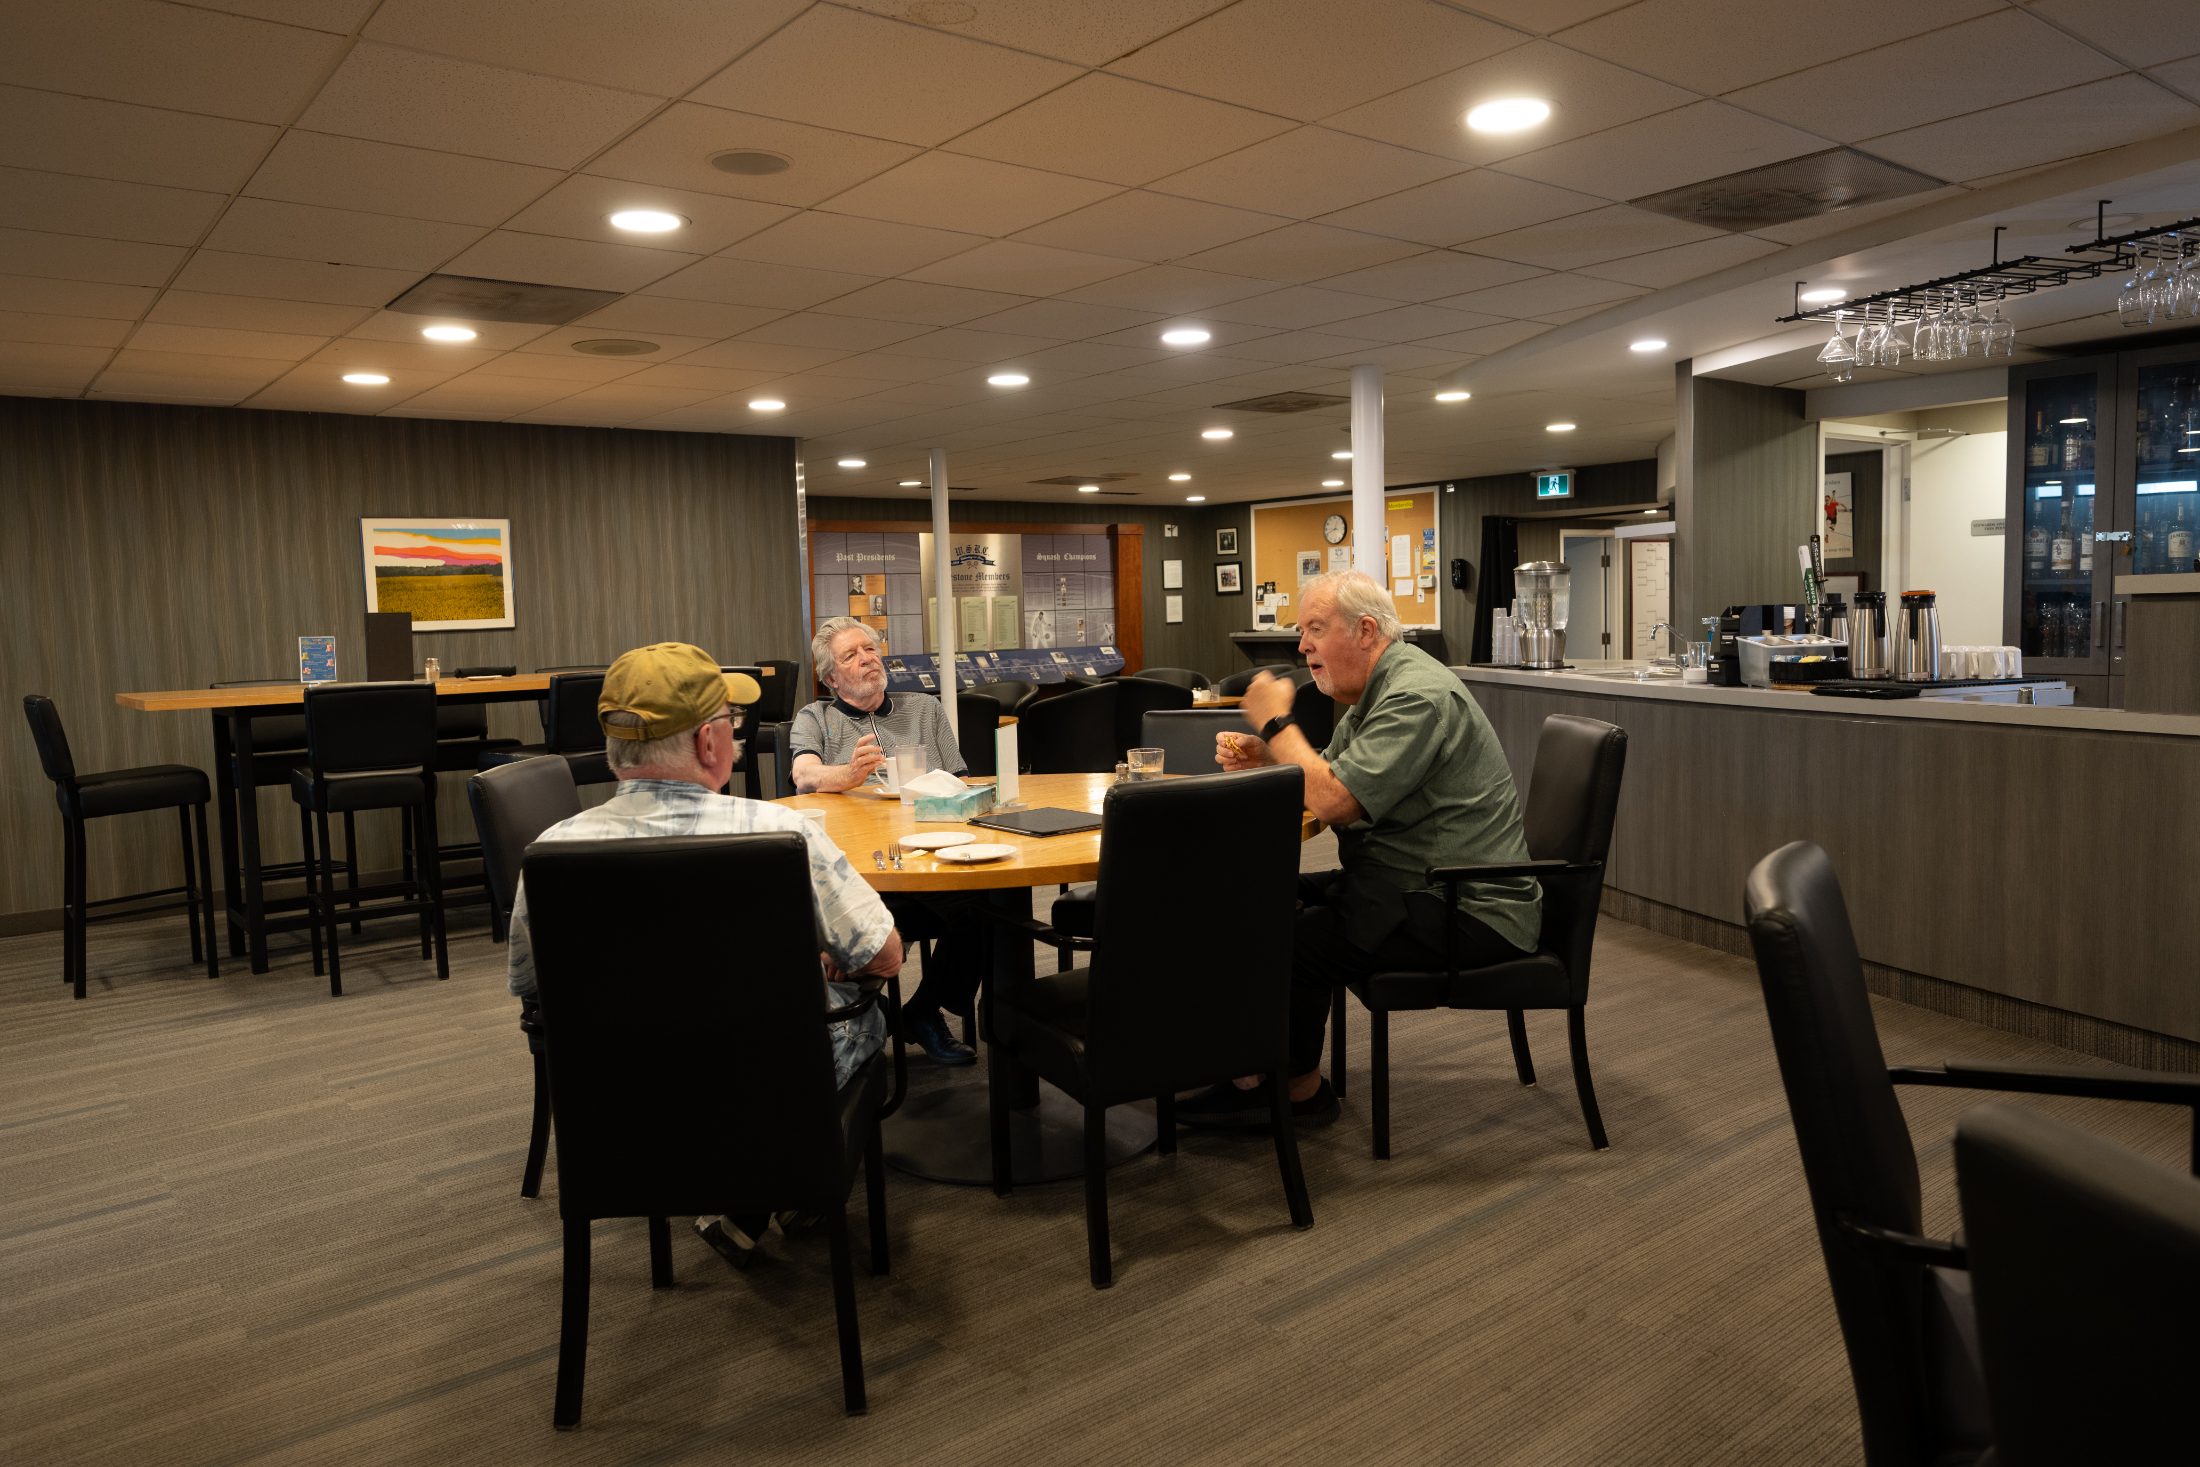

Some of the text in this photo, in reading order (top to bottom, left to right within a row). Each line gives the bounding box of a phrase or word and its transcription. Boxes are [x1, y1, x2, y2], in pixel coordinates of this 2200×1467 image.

[836, 552, 896, 563] Past Presidents
[1036, 552, 1097, 562] Squash Champions
[975, 571, 1011, 581] Members
